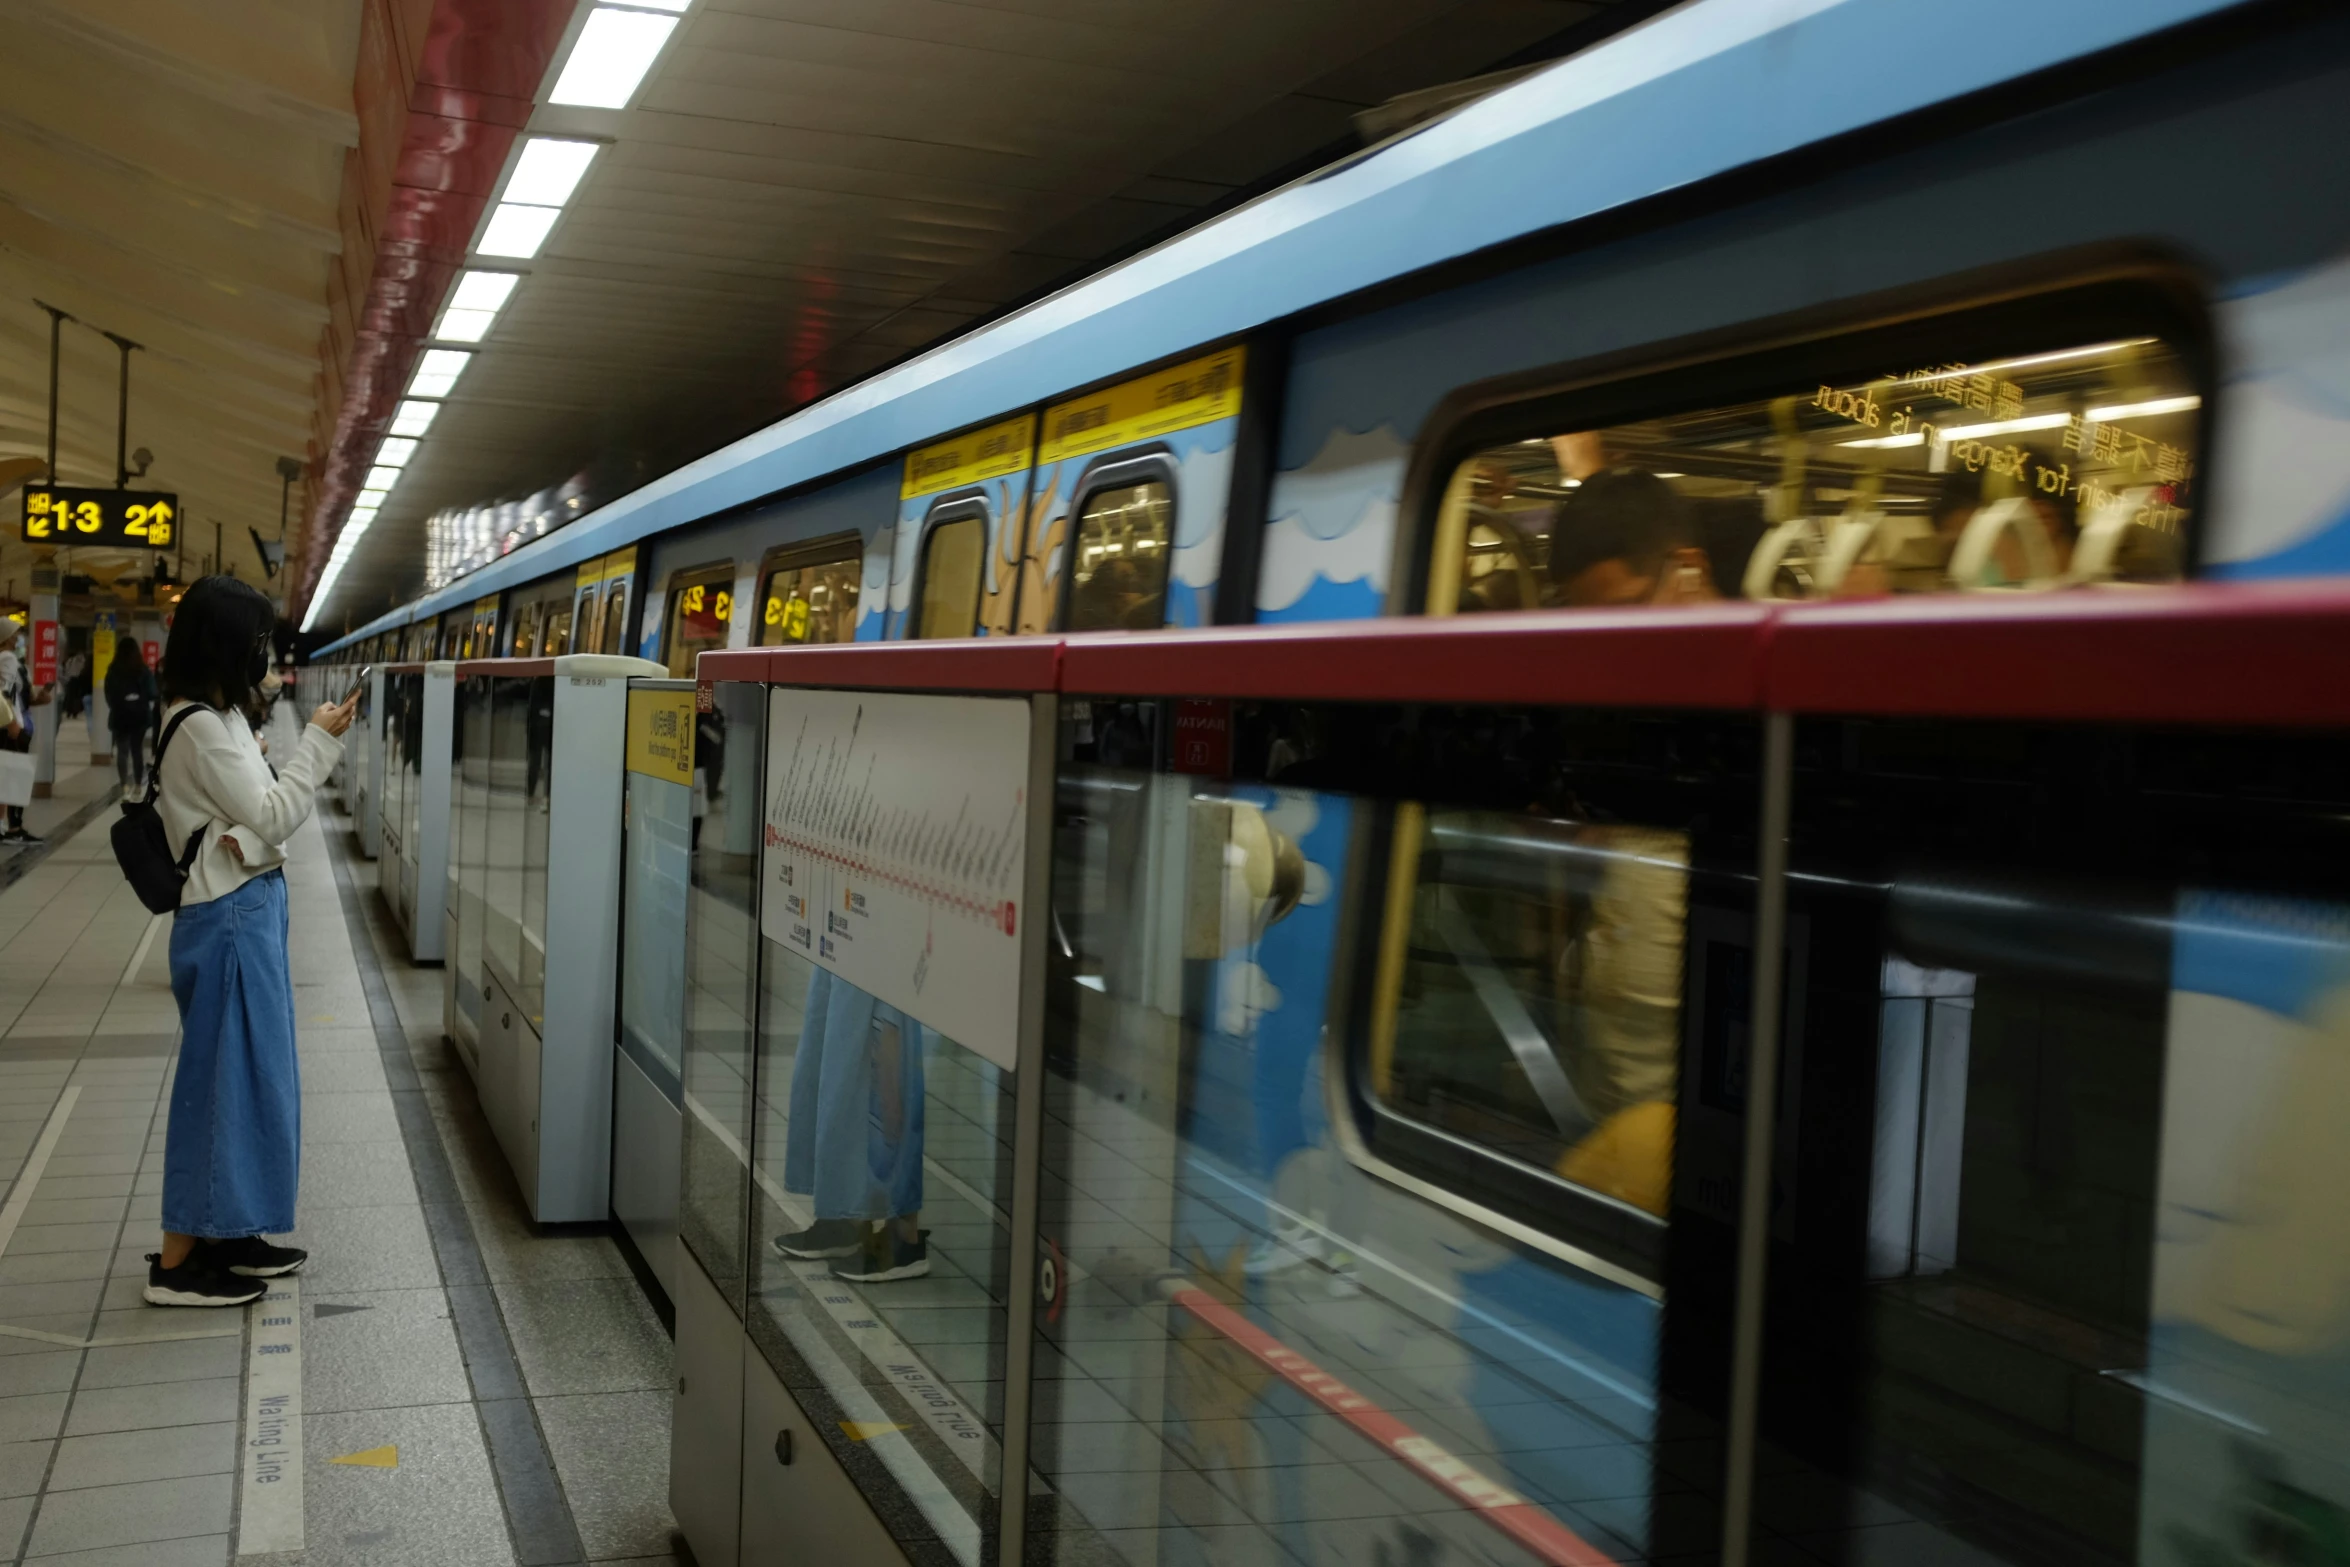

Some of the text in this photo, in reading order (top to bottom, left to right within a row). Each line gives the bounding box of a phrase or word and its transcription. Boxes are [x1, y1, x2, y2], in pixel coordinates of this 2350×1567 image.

[124, 504, 149, 536] 2
[249, 1395, 290, 1485] Waiting Line
